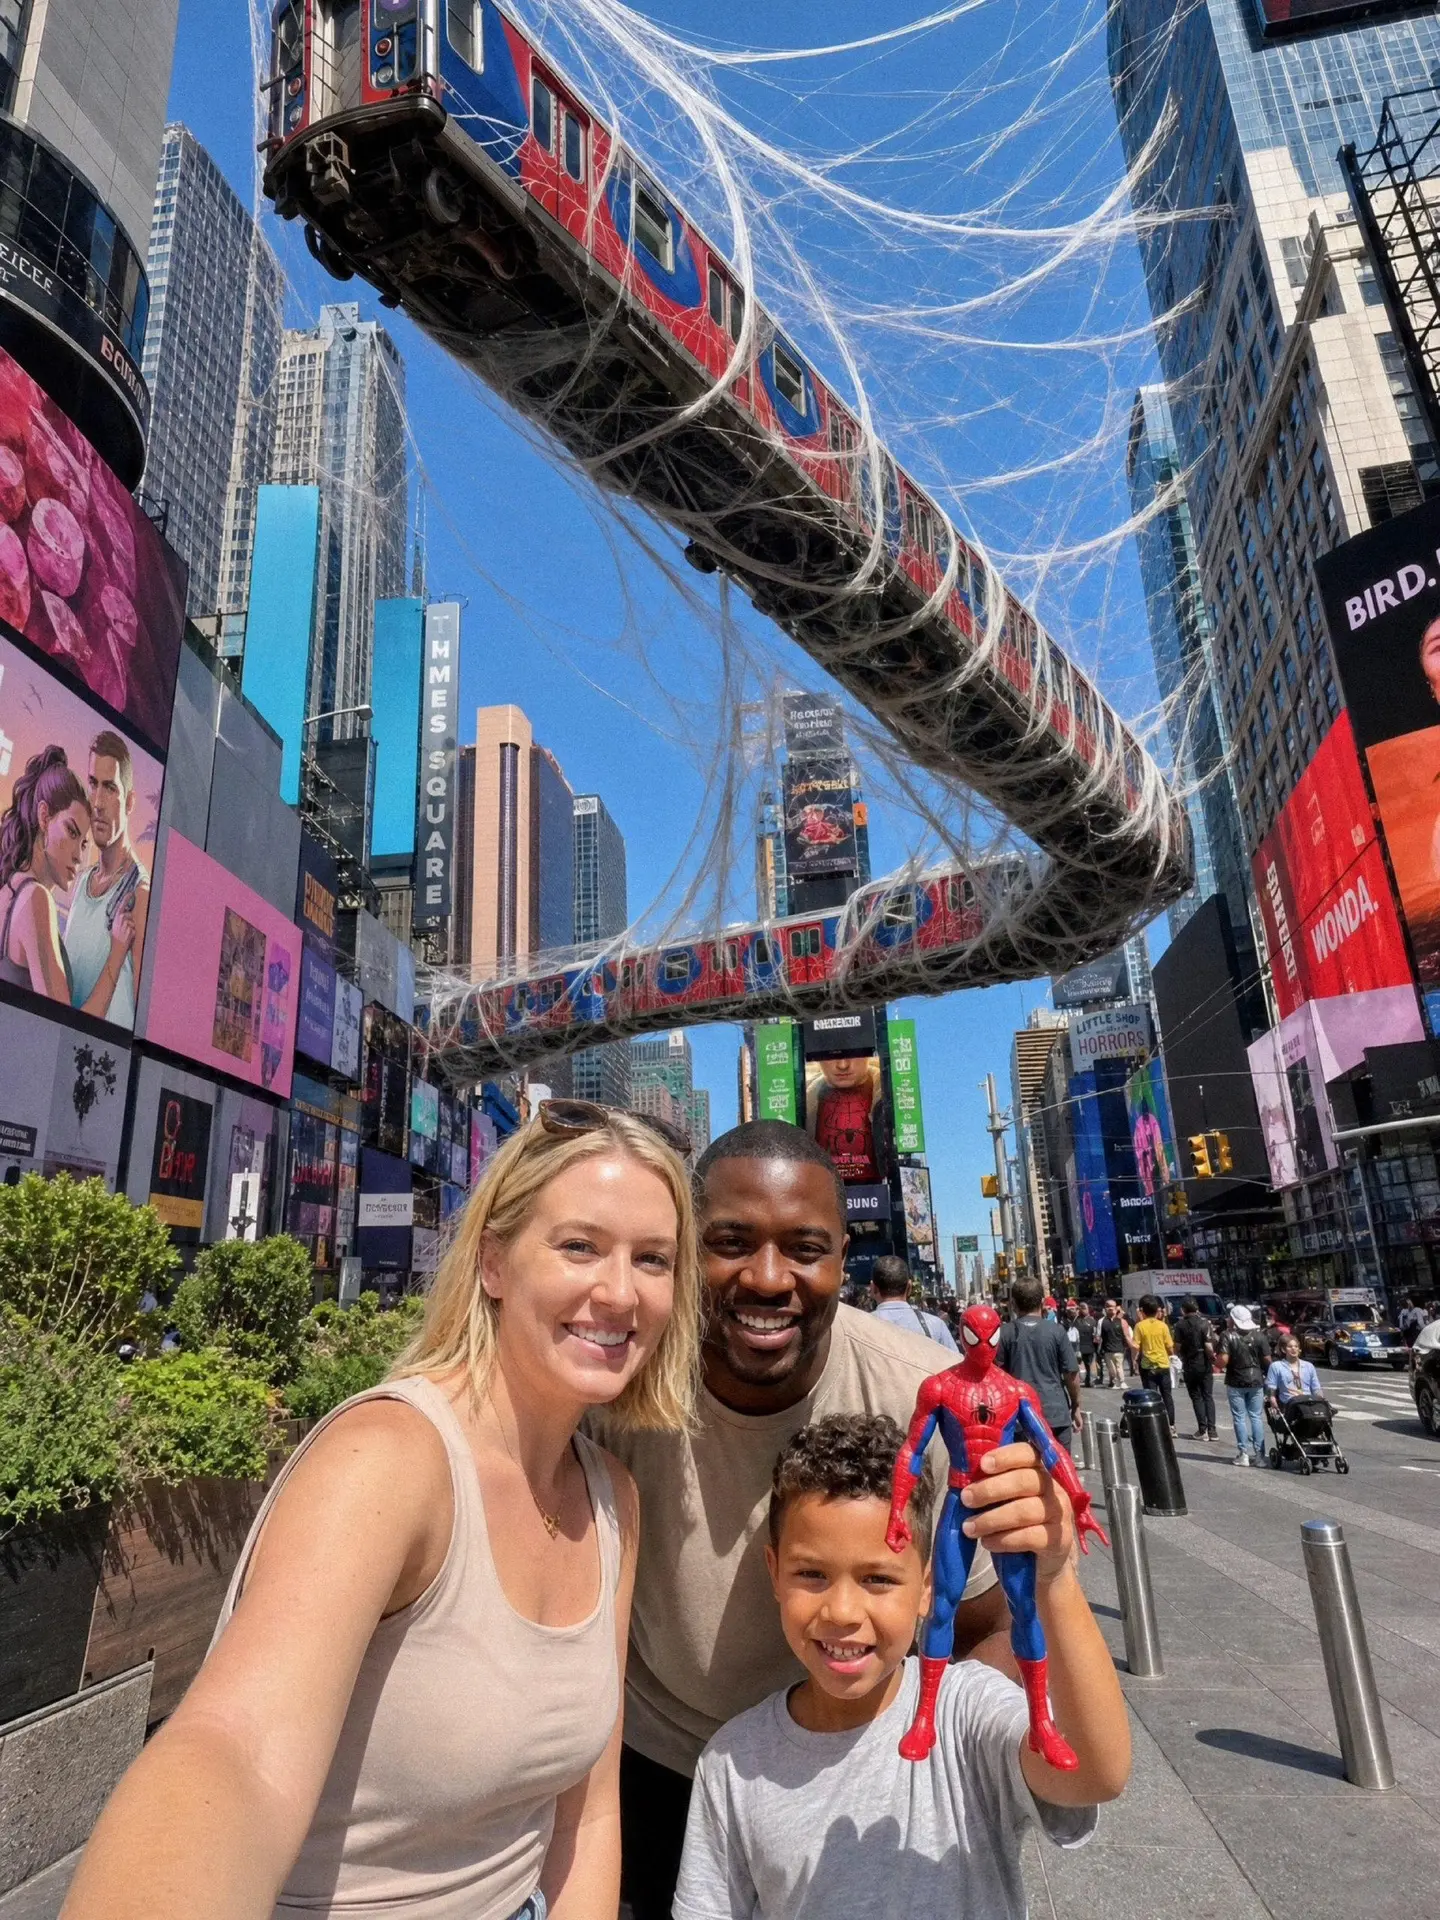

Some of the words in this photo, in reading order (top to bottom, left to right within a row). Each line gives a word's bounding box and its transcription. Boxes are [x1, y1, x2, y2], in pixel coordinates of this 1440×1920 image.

[1345, 564, 1436, 631] BIRD.
[425, 751, 447, 904] SQUARE
[1311, 876, 1379, 964] WONDA.
[1076, 1013, 1112, 1034] LITTLE
[1115, 1012, 1140, 1025] SHOP
[1079, 1031, 1145, 1056] HORRORS
[846, 1196, 878, 1209] SUNG
